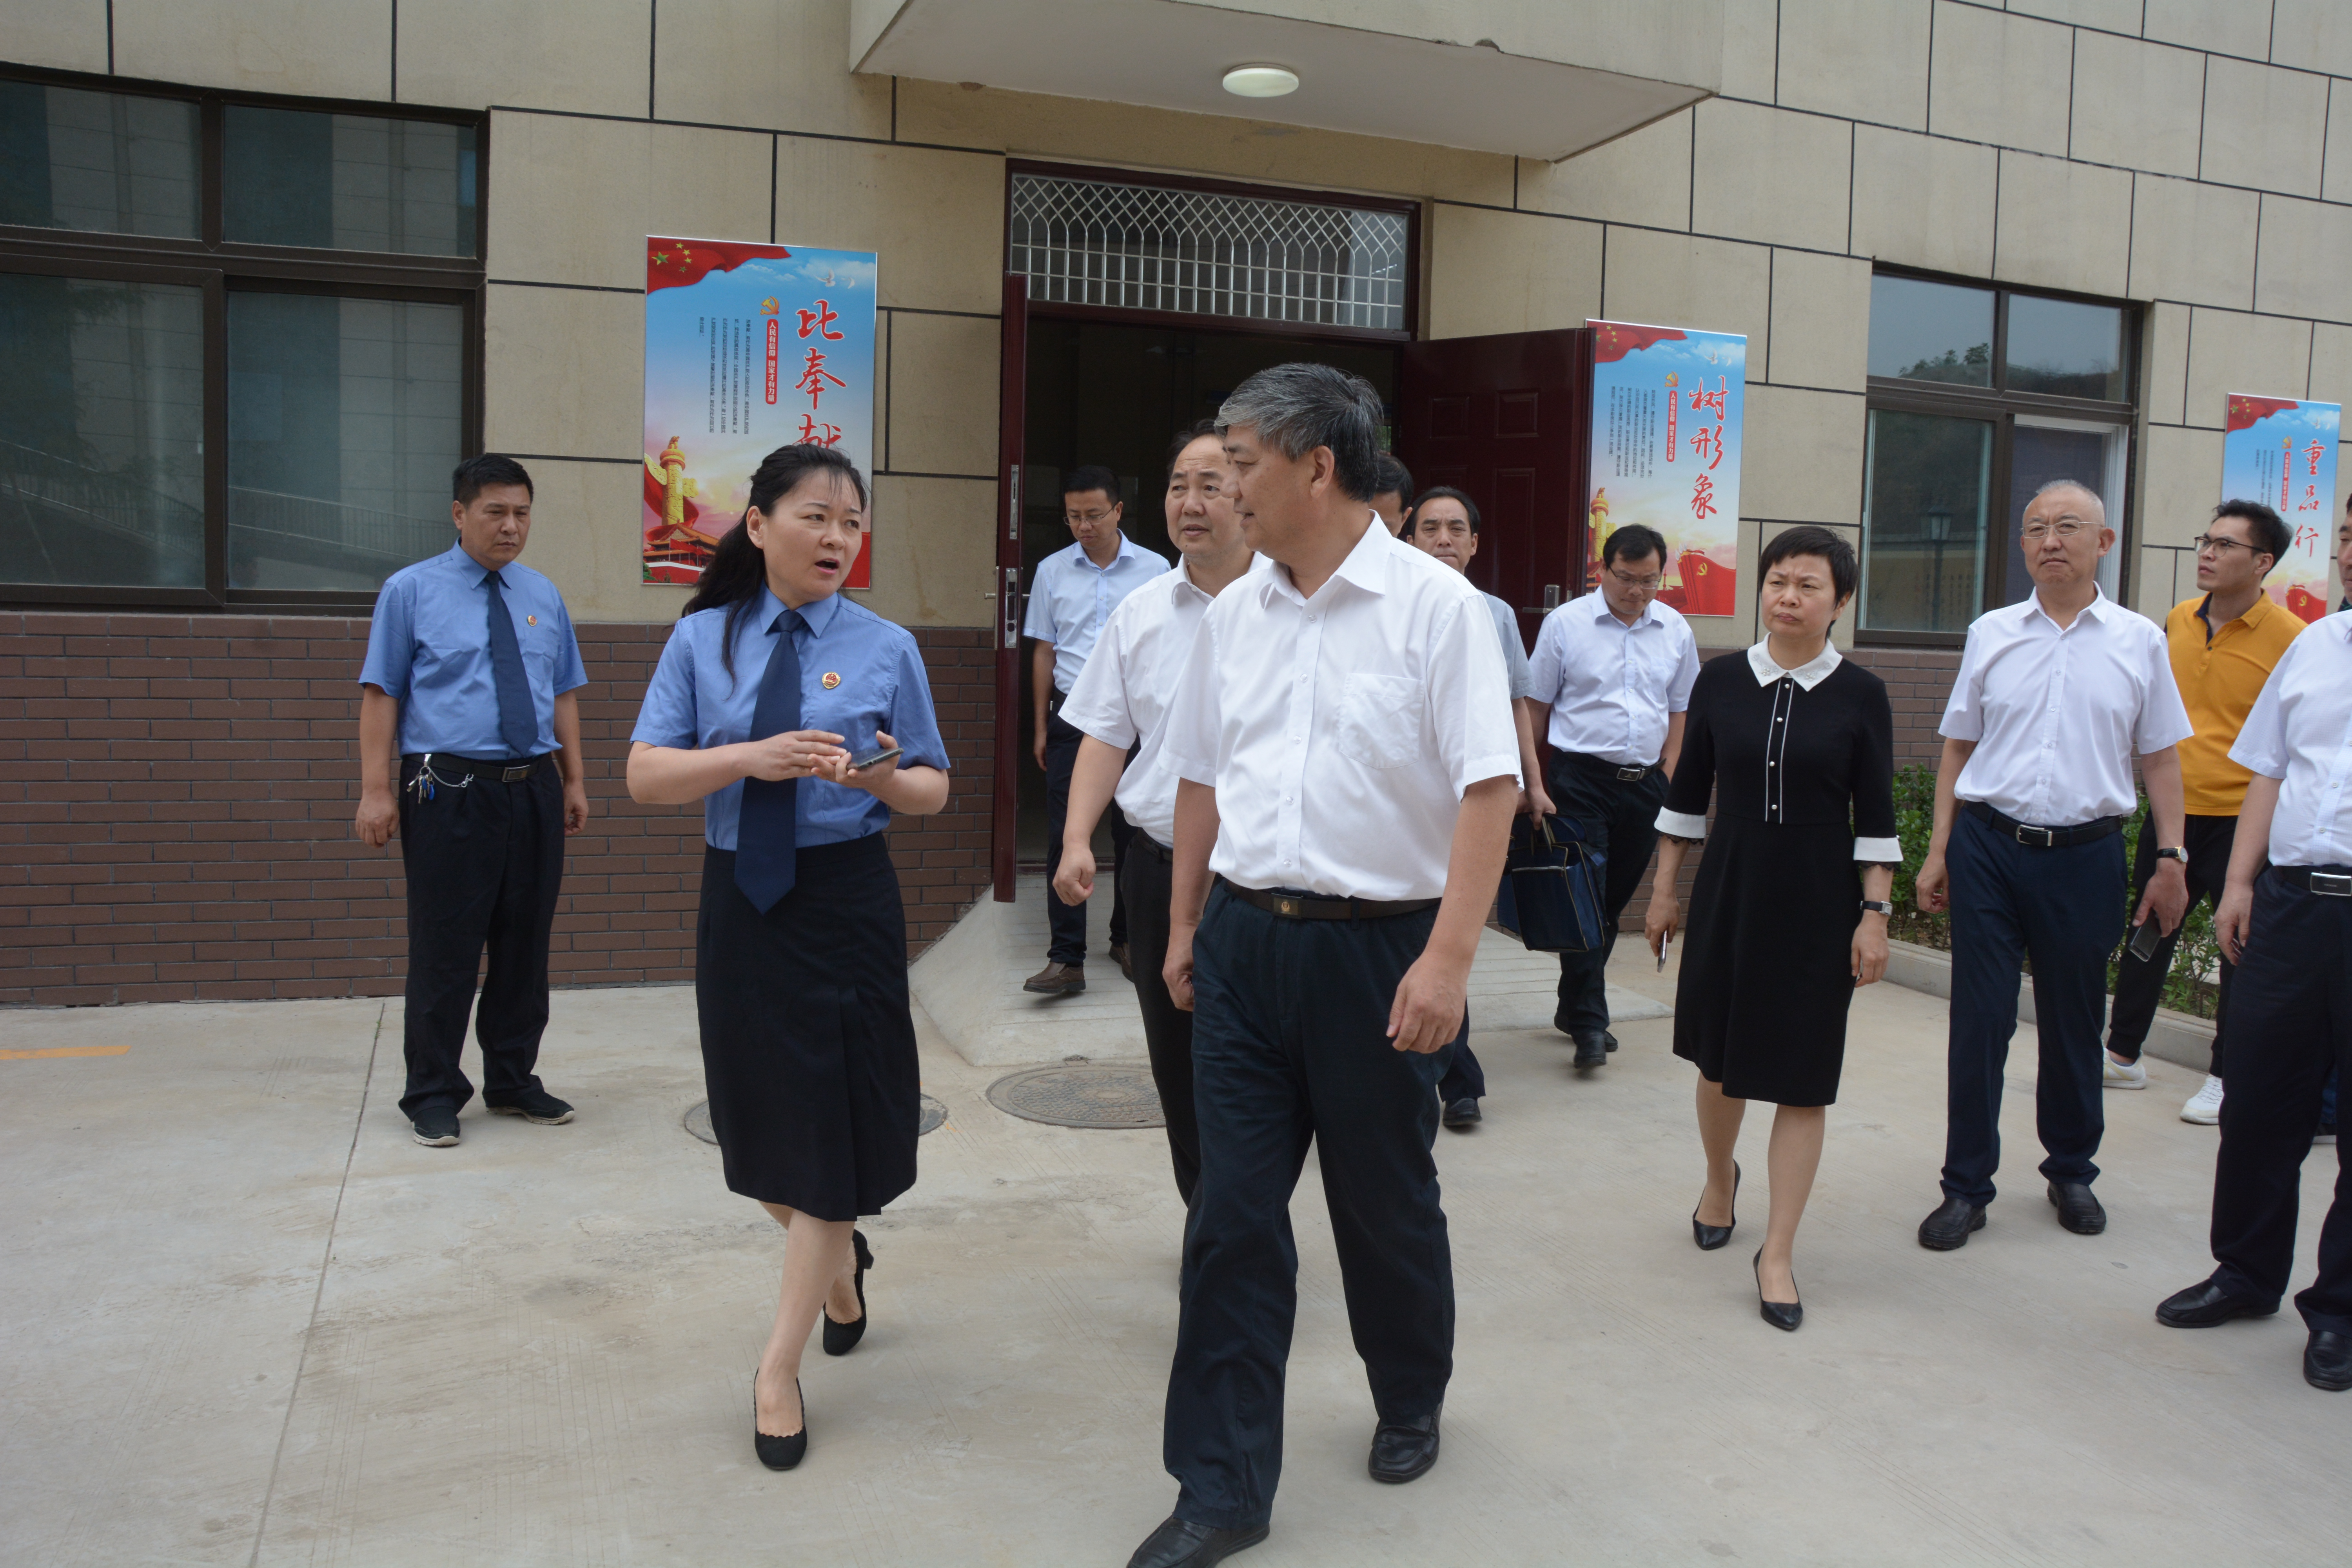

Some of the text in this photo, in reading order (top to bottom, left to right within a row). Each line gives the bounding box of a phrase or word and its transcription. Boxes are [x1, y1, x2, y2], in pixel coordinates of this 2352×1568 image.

[768, 322, 777, 402] 人民有信仰 国家才有力量
[1688, 375, 1728, 519] 树形象
[2295, 438, 2326, 557] 重品行
